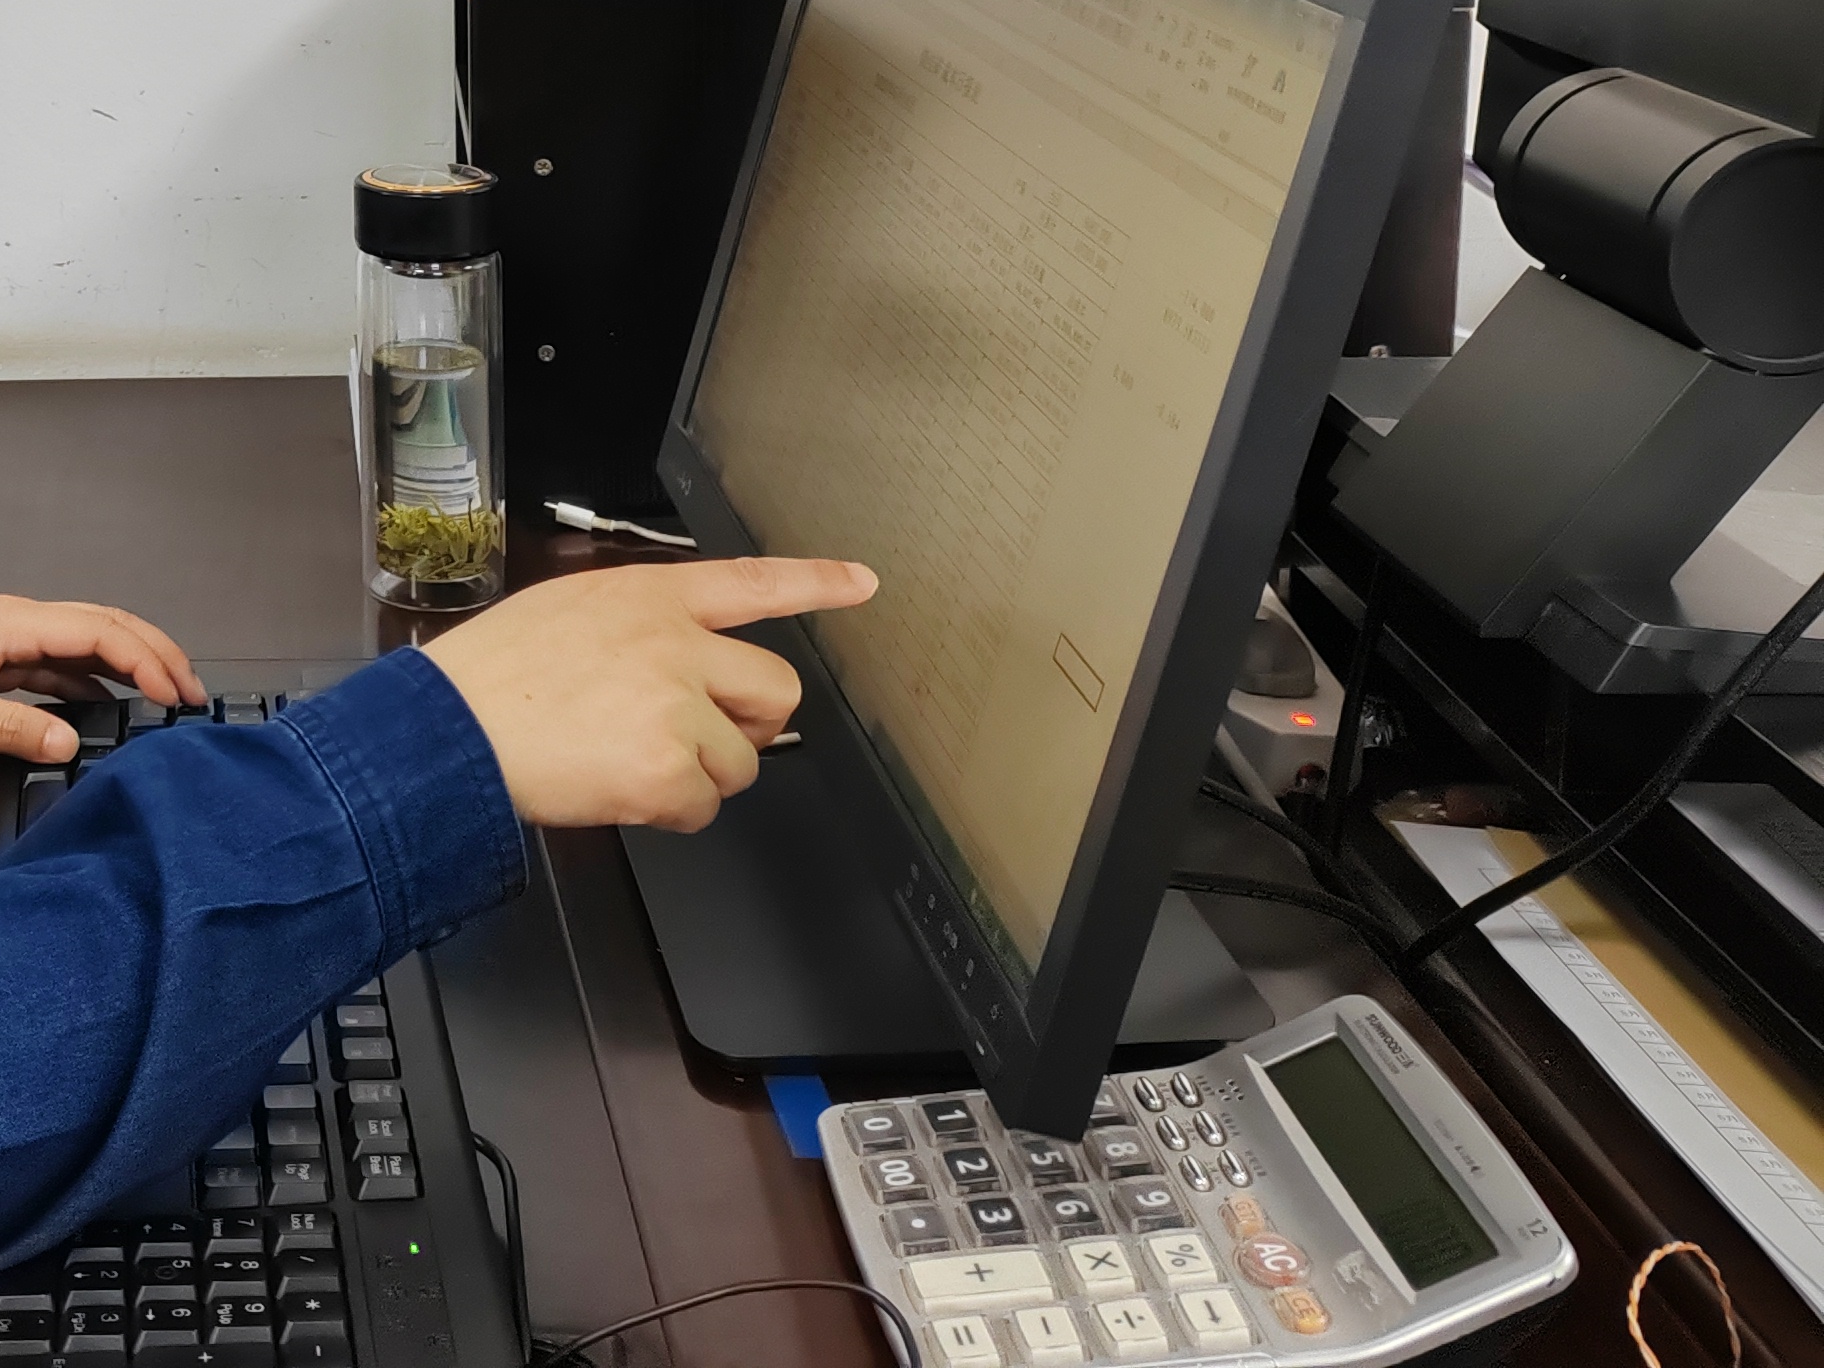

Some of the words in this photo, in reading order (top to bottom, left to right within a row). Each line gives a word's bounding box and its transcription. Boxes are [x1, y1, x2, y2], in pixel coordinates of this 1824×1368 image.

[863, 1116, 893, 1131] 0
[936, 1108, 968, 1123] 1
[1105, 1142, 1139, 1158] 8
[955, 1157, 989, 1175] 2
[1031, 1150, 1065, 1167] 5
[878, 1158, 917, 1187] 00
[1135, 1190, 1172, 1207] 9
[978, 1206, 1013, 1224] 3
[1055, 1199, 1090, 1216] 6
[1526, 1217, 1549, 1238] 12
[173, 1259, 191, 1270] 5
[240, 1260, 259, 1271] 8
[1253, 1242, 1298, 1273] AC
[100, 1270, 119, 1280] 2
[171, 1307, 191, 1318] 6
[245, 1302, 265, 1314] 9
[100, 1312, 119, 1324] 3
